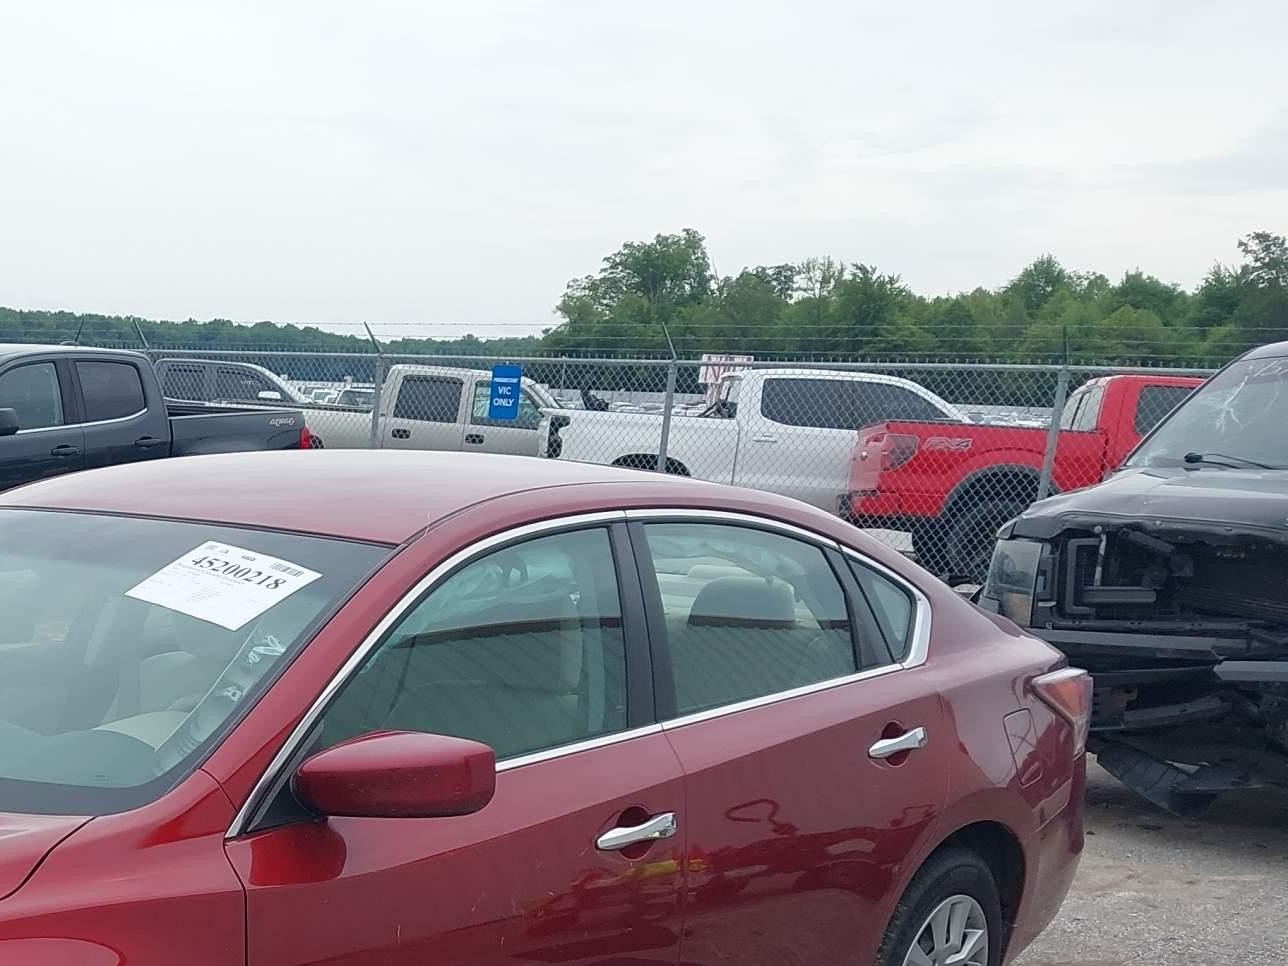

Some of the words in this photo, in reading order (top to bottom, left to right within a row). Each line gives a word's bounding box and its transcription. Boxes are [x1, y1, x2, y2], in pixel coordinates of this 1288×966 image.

[498, 386, 512, 395] VIC
[493, 397, 515, 407] ONLY
[191, 555, 287, 590] 45200218
